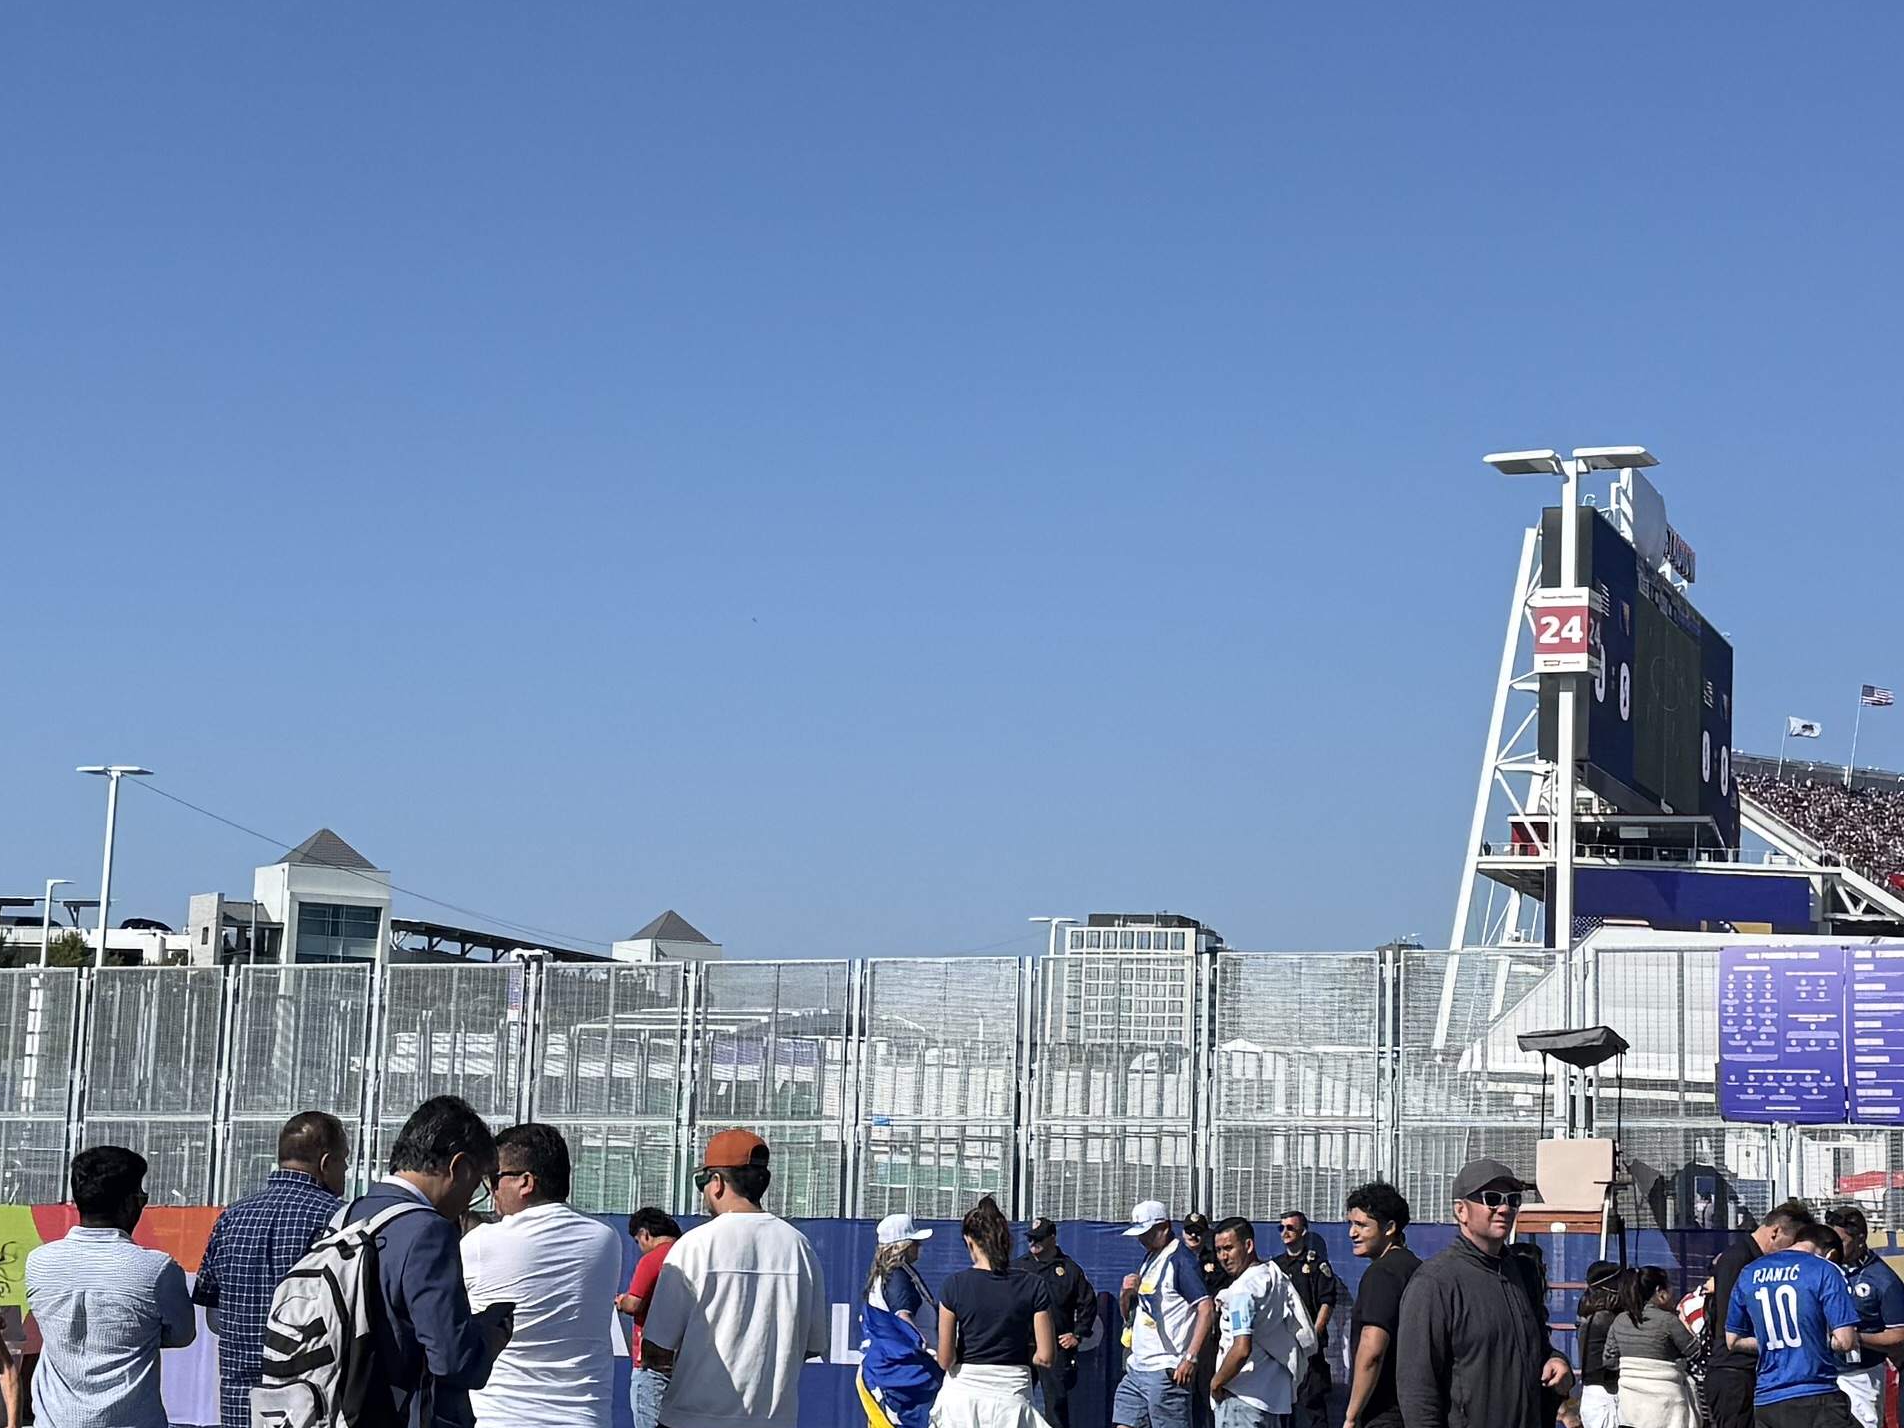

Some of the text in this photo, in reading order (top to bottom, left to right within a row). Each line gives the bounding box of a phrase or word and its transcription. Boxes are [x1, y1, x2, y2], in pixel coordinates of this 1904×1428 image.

[1539, 615, 1584, 644] 24
[1752, 1263, 1801, 1284] PJANIĆ
[1754, 1284, 1802, 1351] 10
